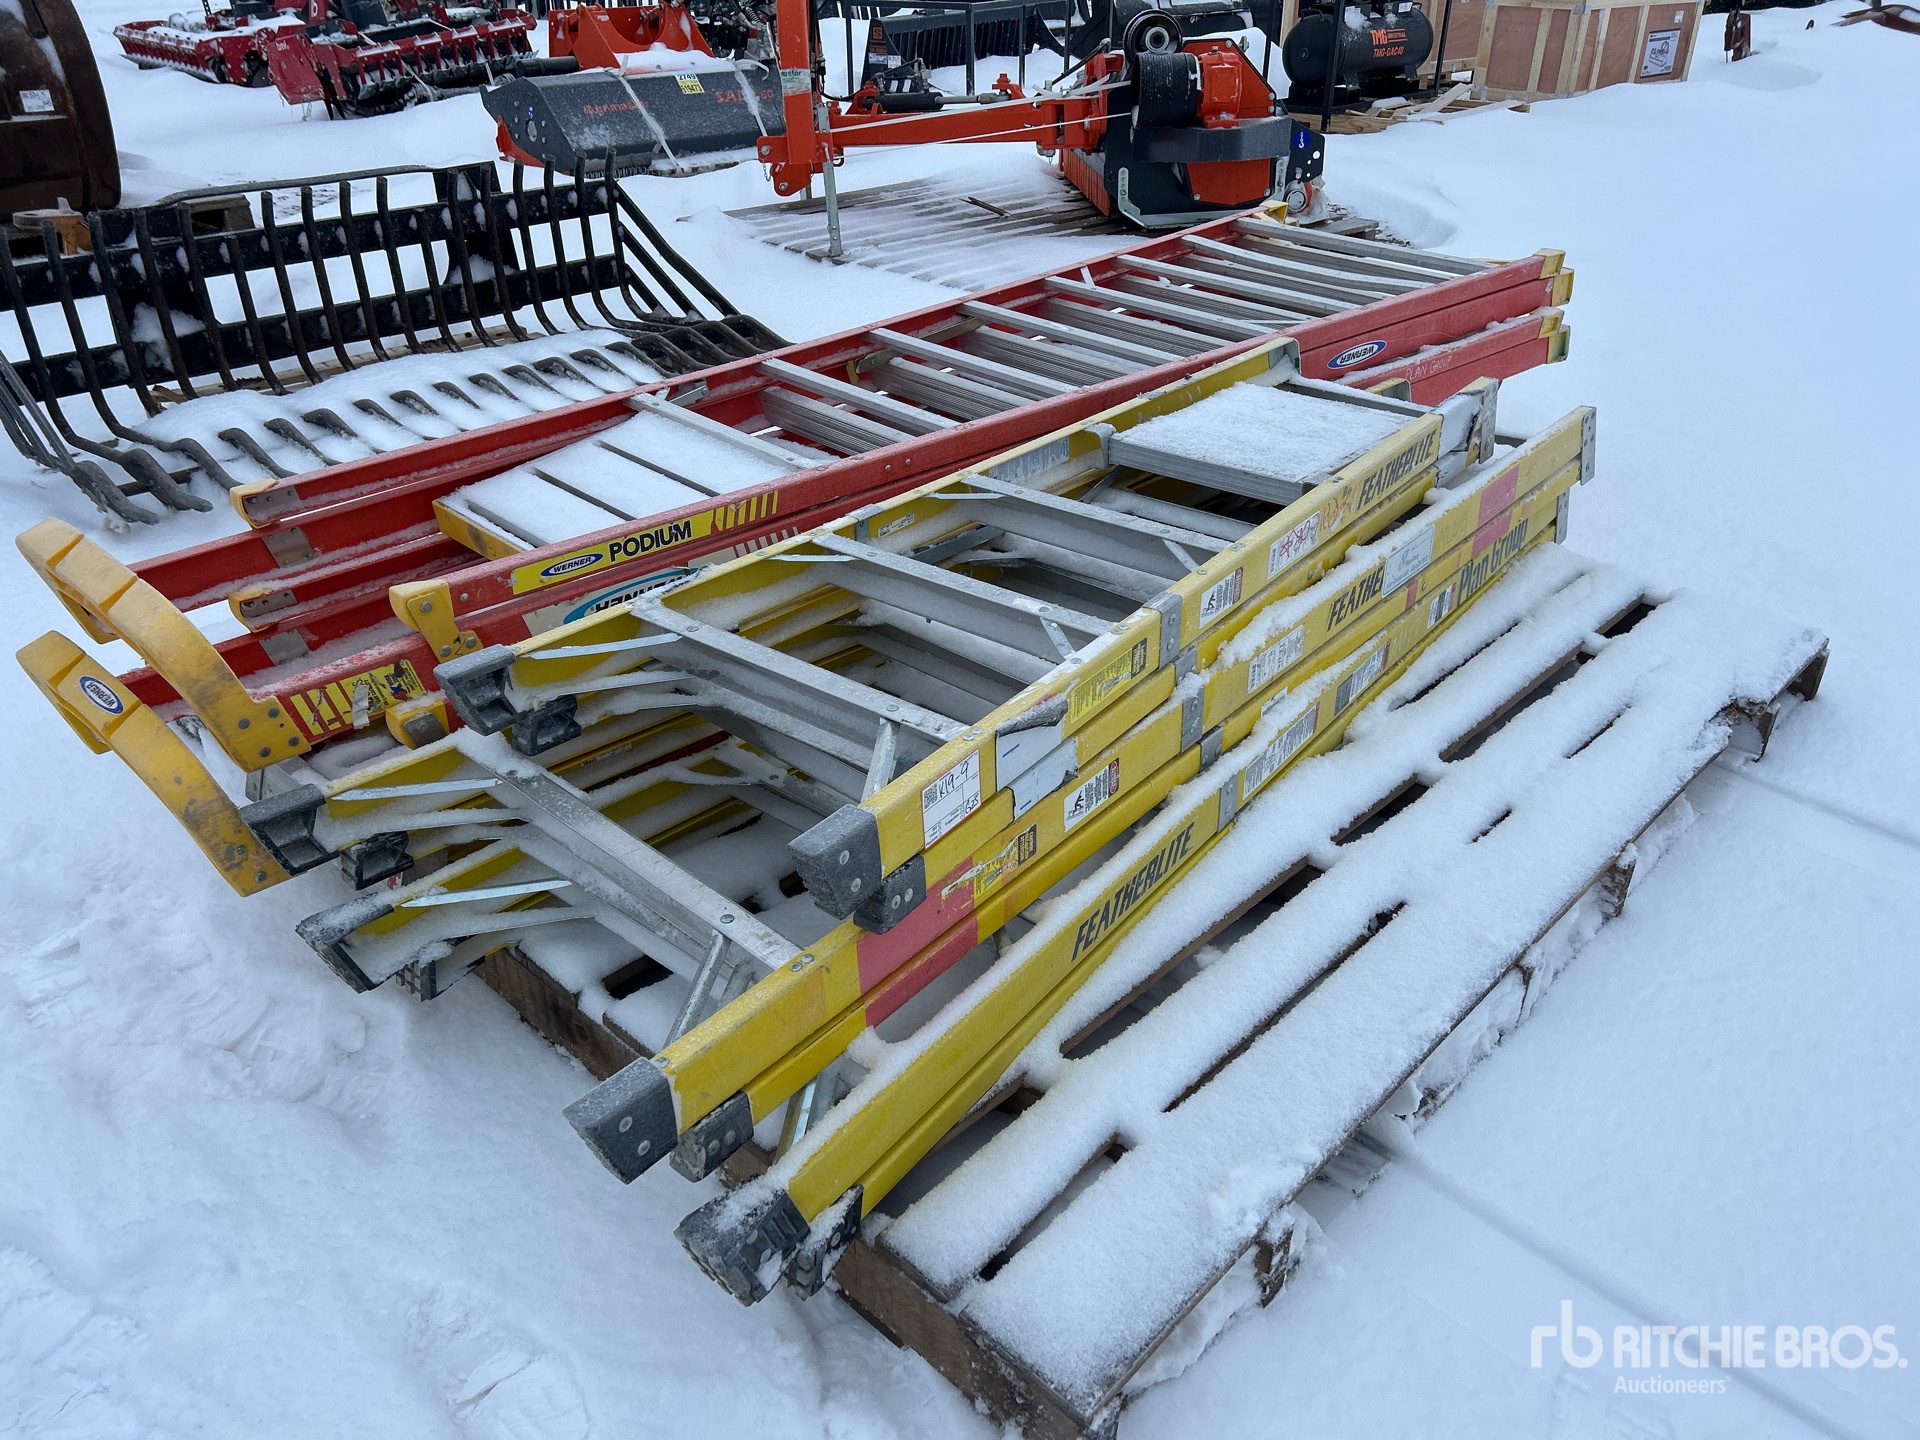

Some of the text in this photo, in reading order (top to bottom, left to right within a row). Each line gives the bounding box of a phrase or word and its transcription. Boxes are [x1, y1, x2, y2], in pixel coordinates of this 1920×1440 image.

[1370, 29, 1388, 45] TMG
[1340, 345, 1375, 364] WERNER
[1406, 356, 1453, 380] PLAN GROUP
[553, 520, 692, 574] WERNER PODIUM
[1457, 554, 1489, 607] Plan
[1491, 518, 1529, 574] Group
[1327, 565, 1385, 632] FEATHE
[86, 681, 117, 708] WERNER
[1071, 821, 1196, 962] FEATHERLITE
